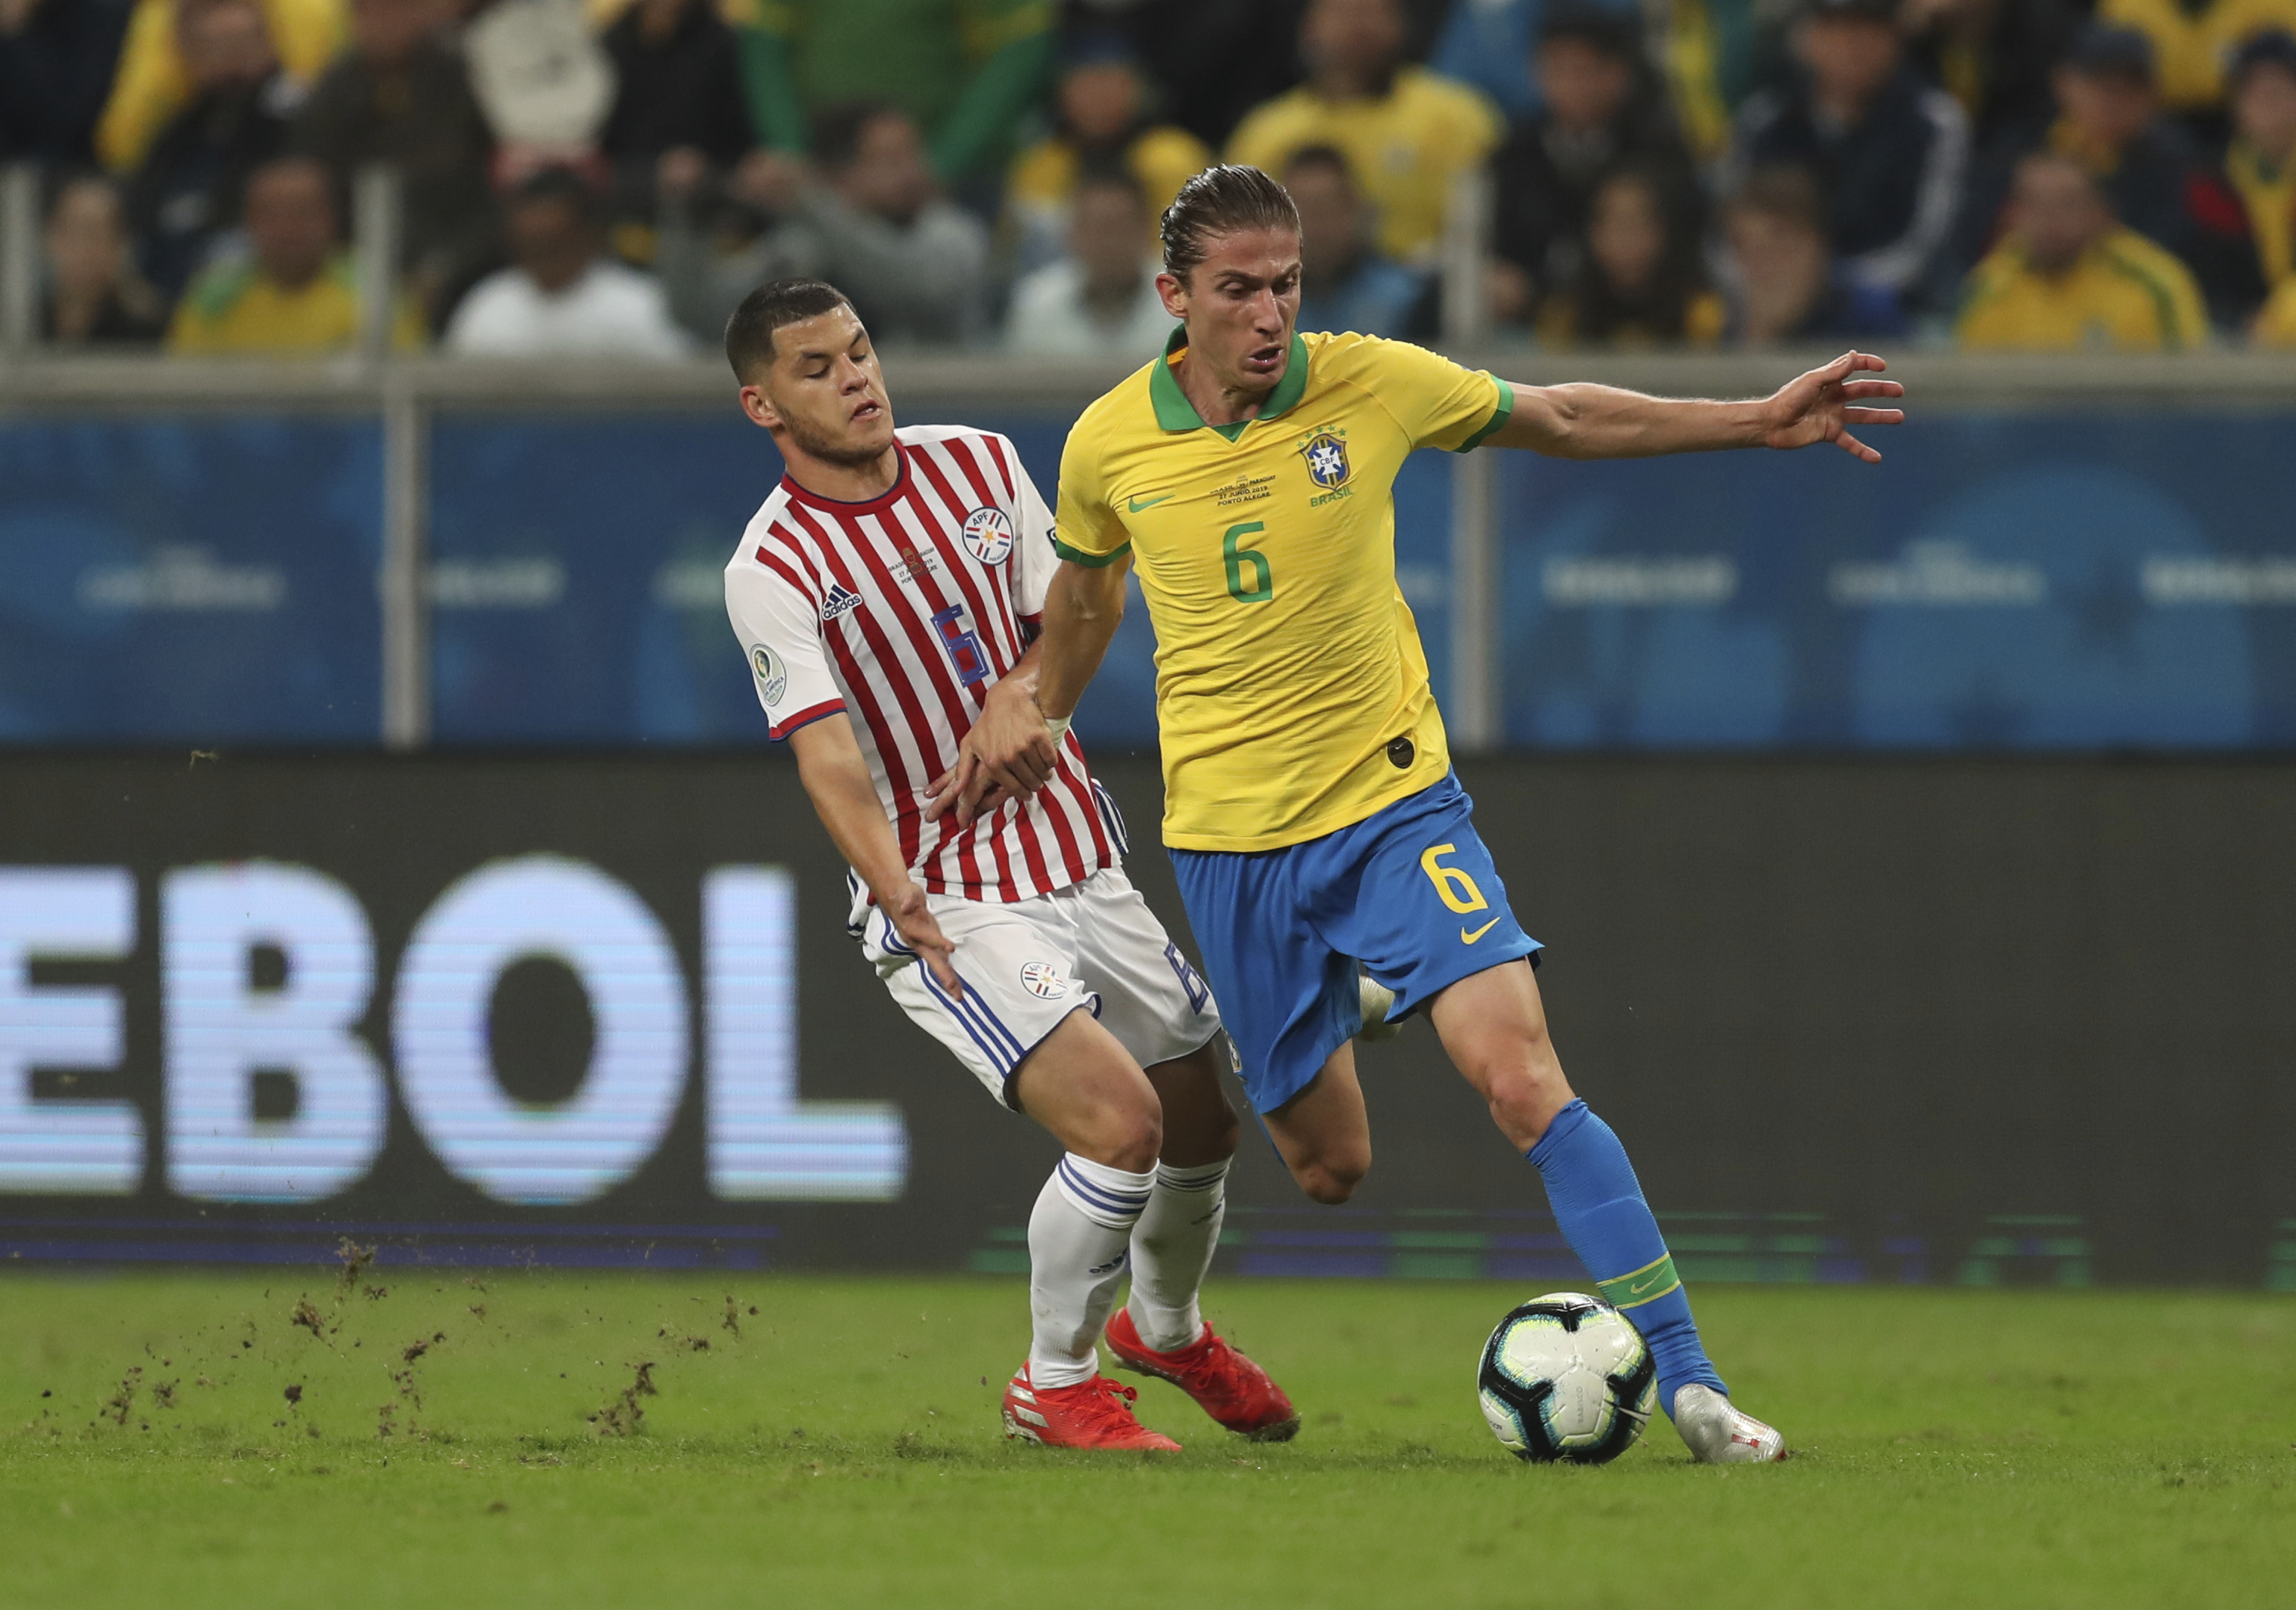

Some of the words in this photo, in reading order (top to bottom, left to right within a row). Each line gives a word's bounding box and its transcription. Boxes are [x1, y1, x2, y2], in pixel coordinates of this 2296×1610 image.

[1320, 457, 1336, 466] CBF
[1249, 475, 1276, 485] PARAGUAY
[1218, 497, 1242, 506] PORTO
[1243, 491, 1271, 502] ALEGRE
[1310, 486, 1354, 508] BRASIL
[972, 511, 989, 527] APF
[1223, 520, 1273, 603] 6
[823, 595, 862, 619] adidas
[930, 602, 991, 689] 6
[1420, 843, 1489, 914] 6
